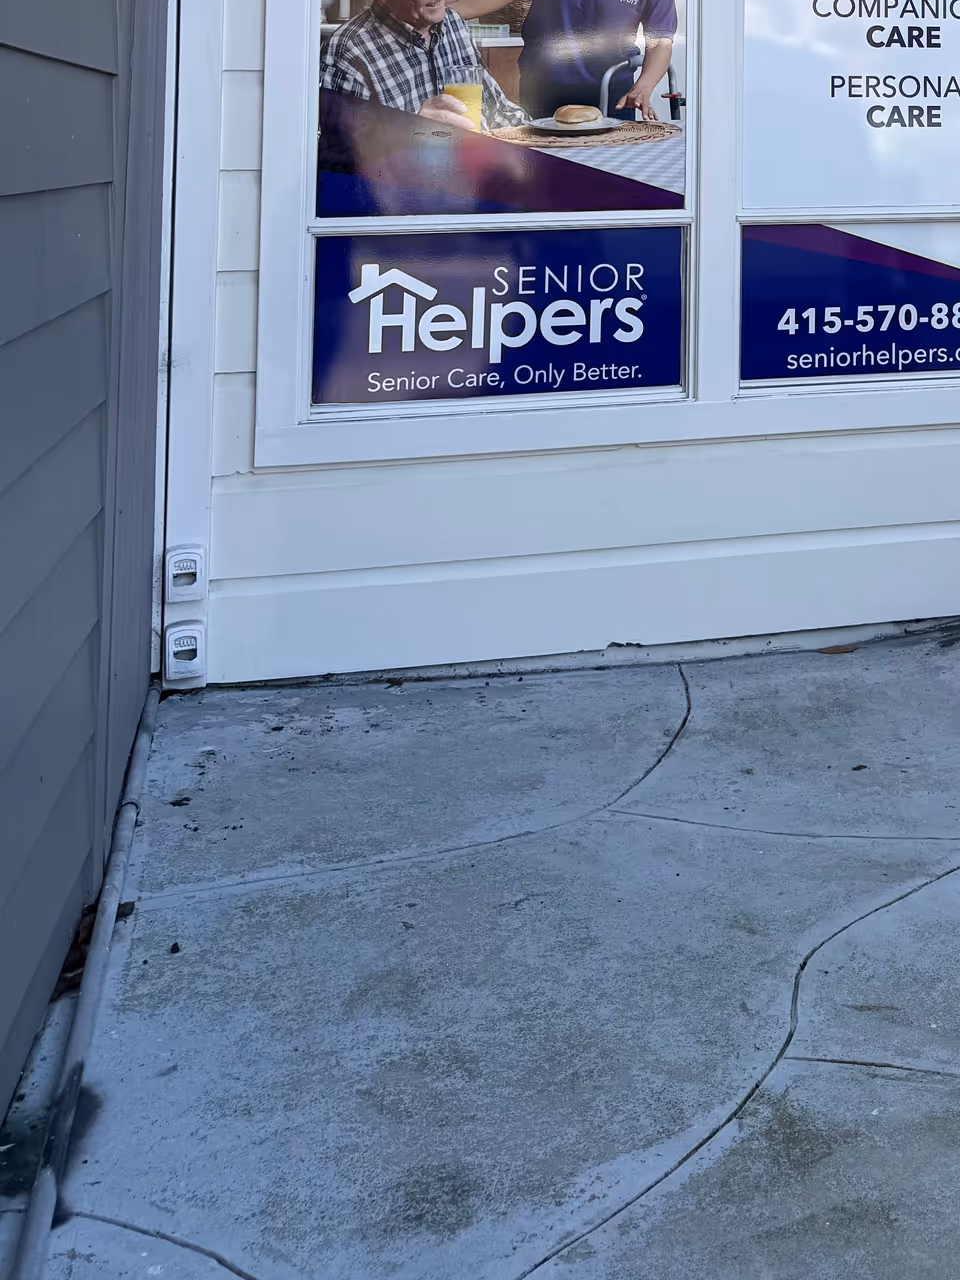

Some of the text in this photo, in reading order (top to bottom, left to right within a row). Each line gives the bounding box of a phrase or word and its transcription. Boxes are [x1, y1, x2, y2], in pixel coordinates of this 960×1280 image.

[866, 25, 942, 48] CARE
[866, 105, 942, 128] CARE
[491, 263, 645, 296] SENIOR
[367, 362, 642, 393] Senior Care, Only Better.
